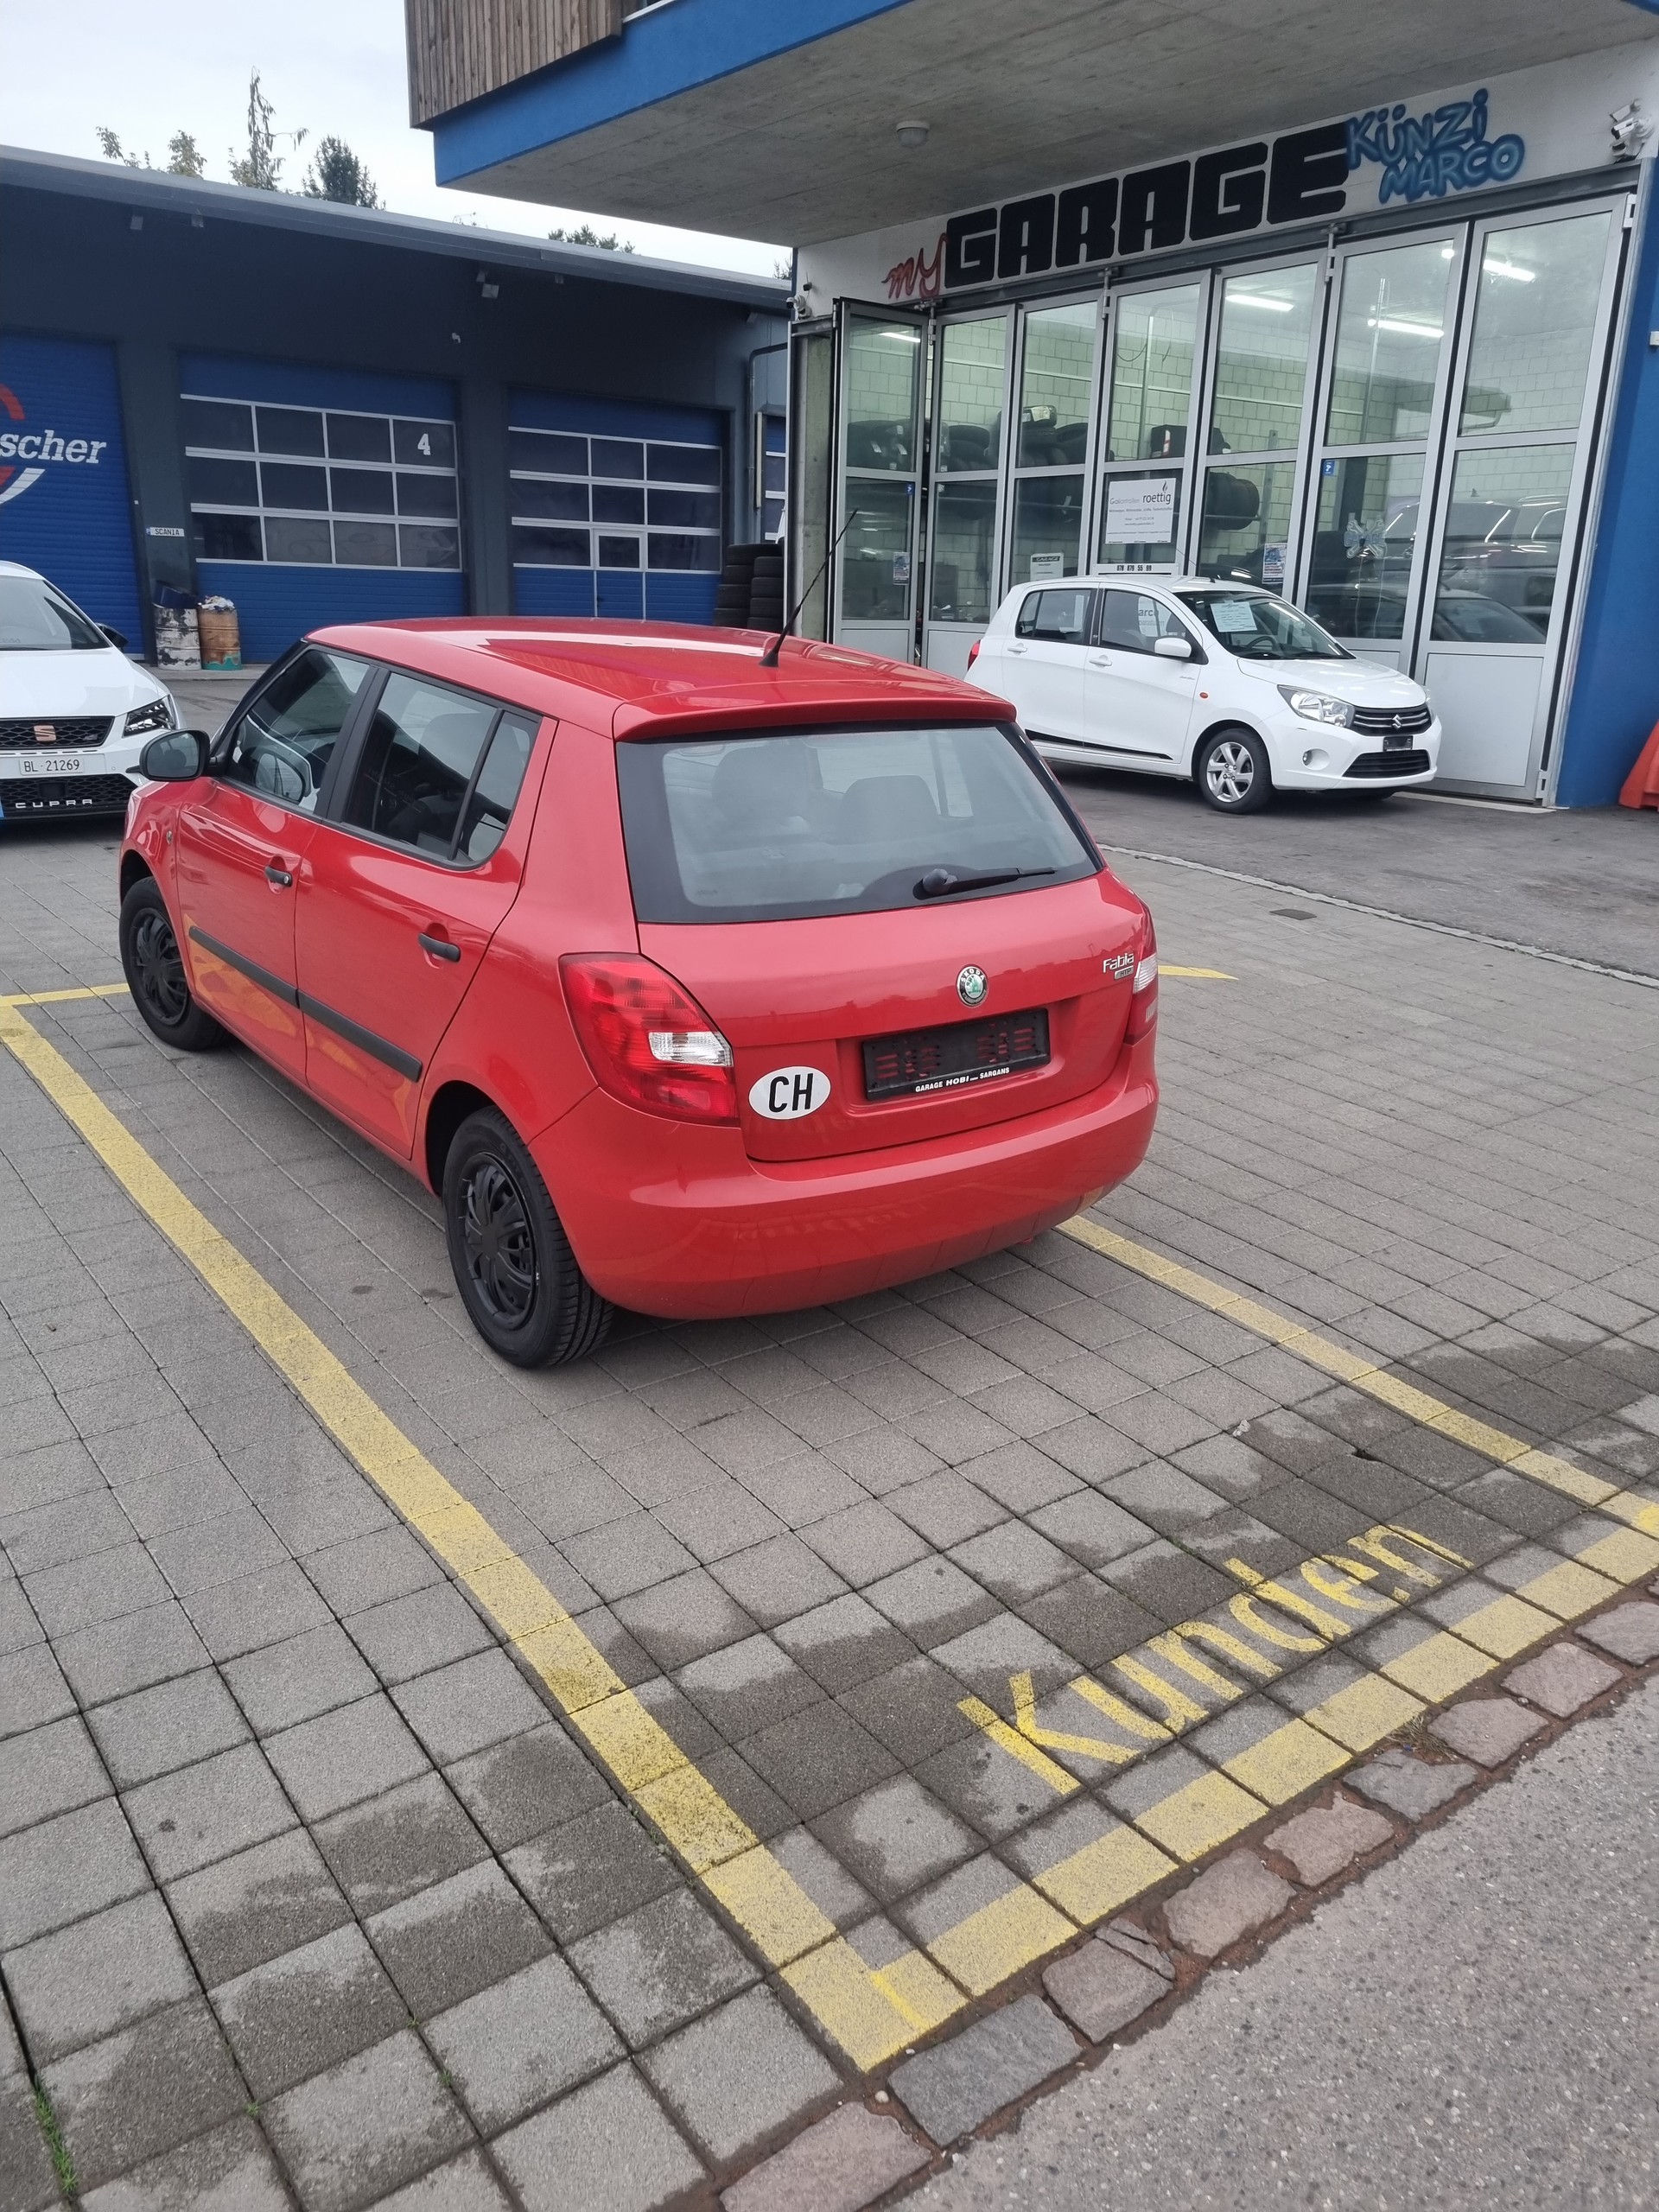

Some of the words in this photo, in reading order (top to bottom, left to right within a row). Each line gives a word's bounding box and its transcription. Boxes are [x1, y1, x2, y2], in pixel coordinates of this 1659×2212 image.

[1378, 133, 1525, 204] MARCO
[944, 122, 1349, 289] GARAGE
[417, 433, 431, 455] 4
[1142, 492, 1172, 505] roettig
[23, 760, 38, 772] BL
[46, 759, 80, 772] 21269
[16, 798, 92, 809] CUPRA
[1103, 953, 1134, 973] Fabia
[915, 1081, 944, 1092] GARAGE
[945, 1075, 969, 1086] HOBI
[979, 1066, 1010, 1079] SARGANS
[768, 1072, 814, 1113] CH
[957, 1524, 1474, 1796] Kunden
